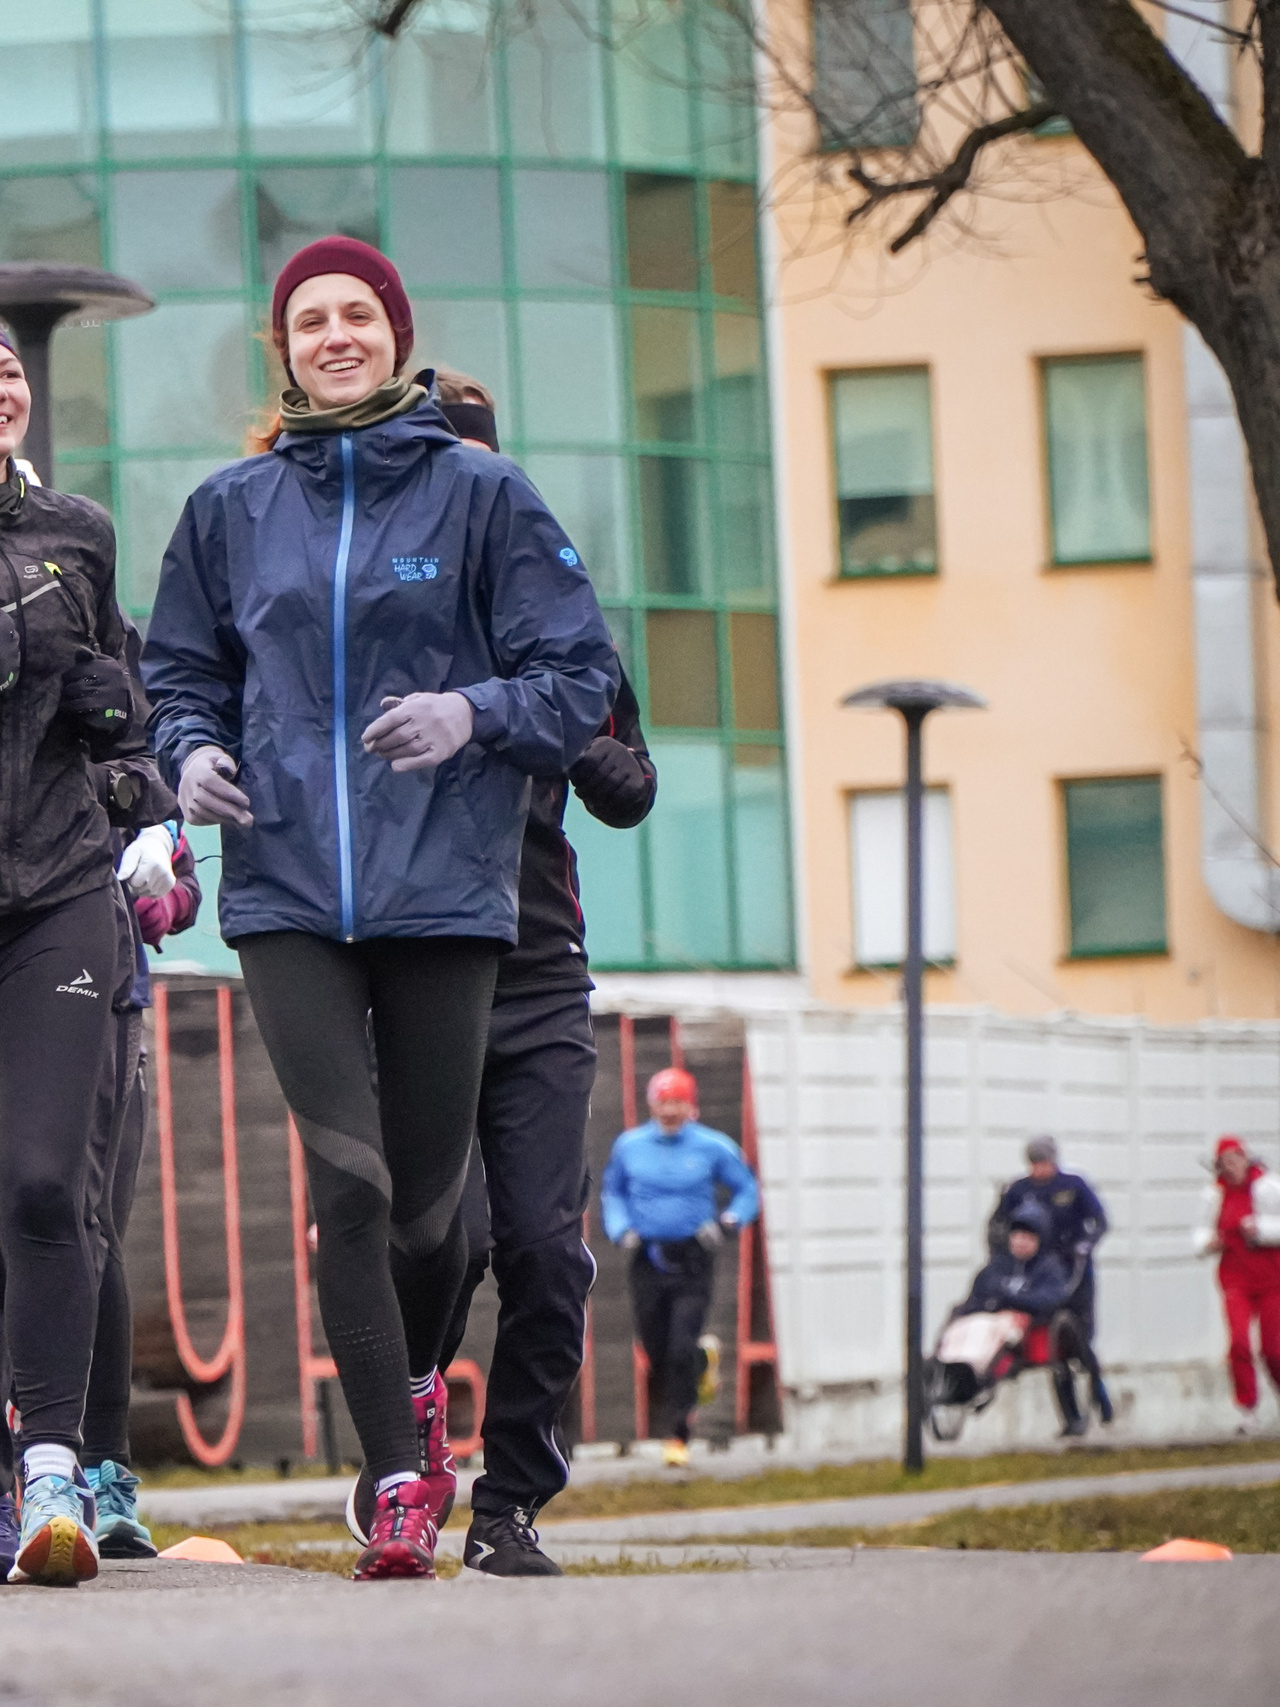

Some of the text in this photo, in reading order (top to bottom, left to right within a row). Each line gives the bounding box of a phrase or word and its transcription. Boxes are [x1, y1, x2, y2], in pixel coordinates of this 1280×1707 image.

[394, 564, 417, 573] HARD
[400, 571, 423, 581] WEAR
[56, 985, 99, 999] DEMIX
